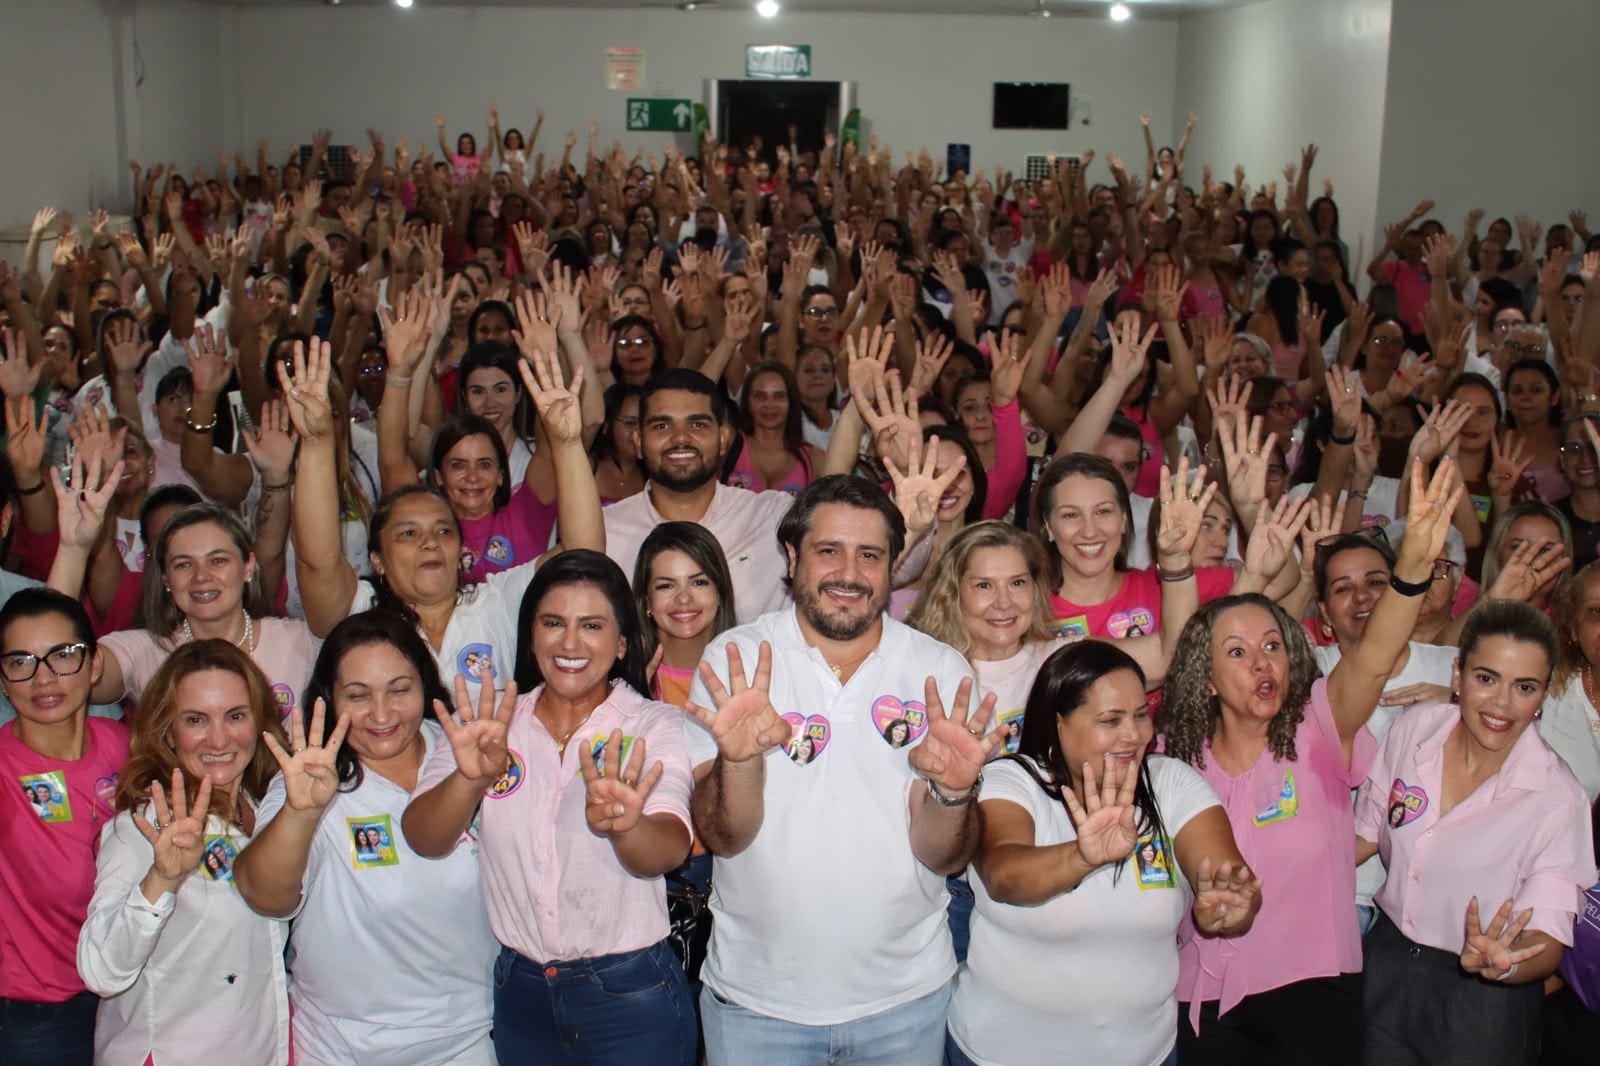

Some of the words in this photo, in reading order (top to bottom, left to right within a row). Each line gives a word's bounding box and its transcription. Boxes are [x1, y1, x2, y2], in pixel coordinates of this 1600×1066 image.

[1135, 614, 1148, 625] 44
[904, 711, 922, 726] 44
[810, 726, 824, 739] 44
[494, 781, 508, 792] 44
[1404, 796, 1420, 811] 44
[378, 847, 393, 861] 44
